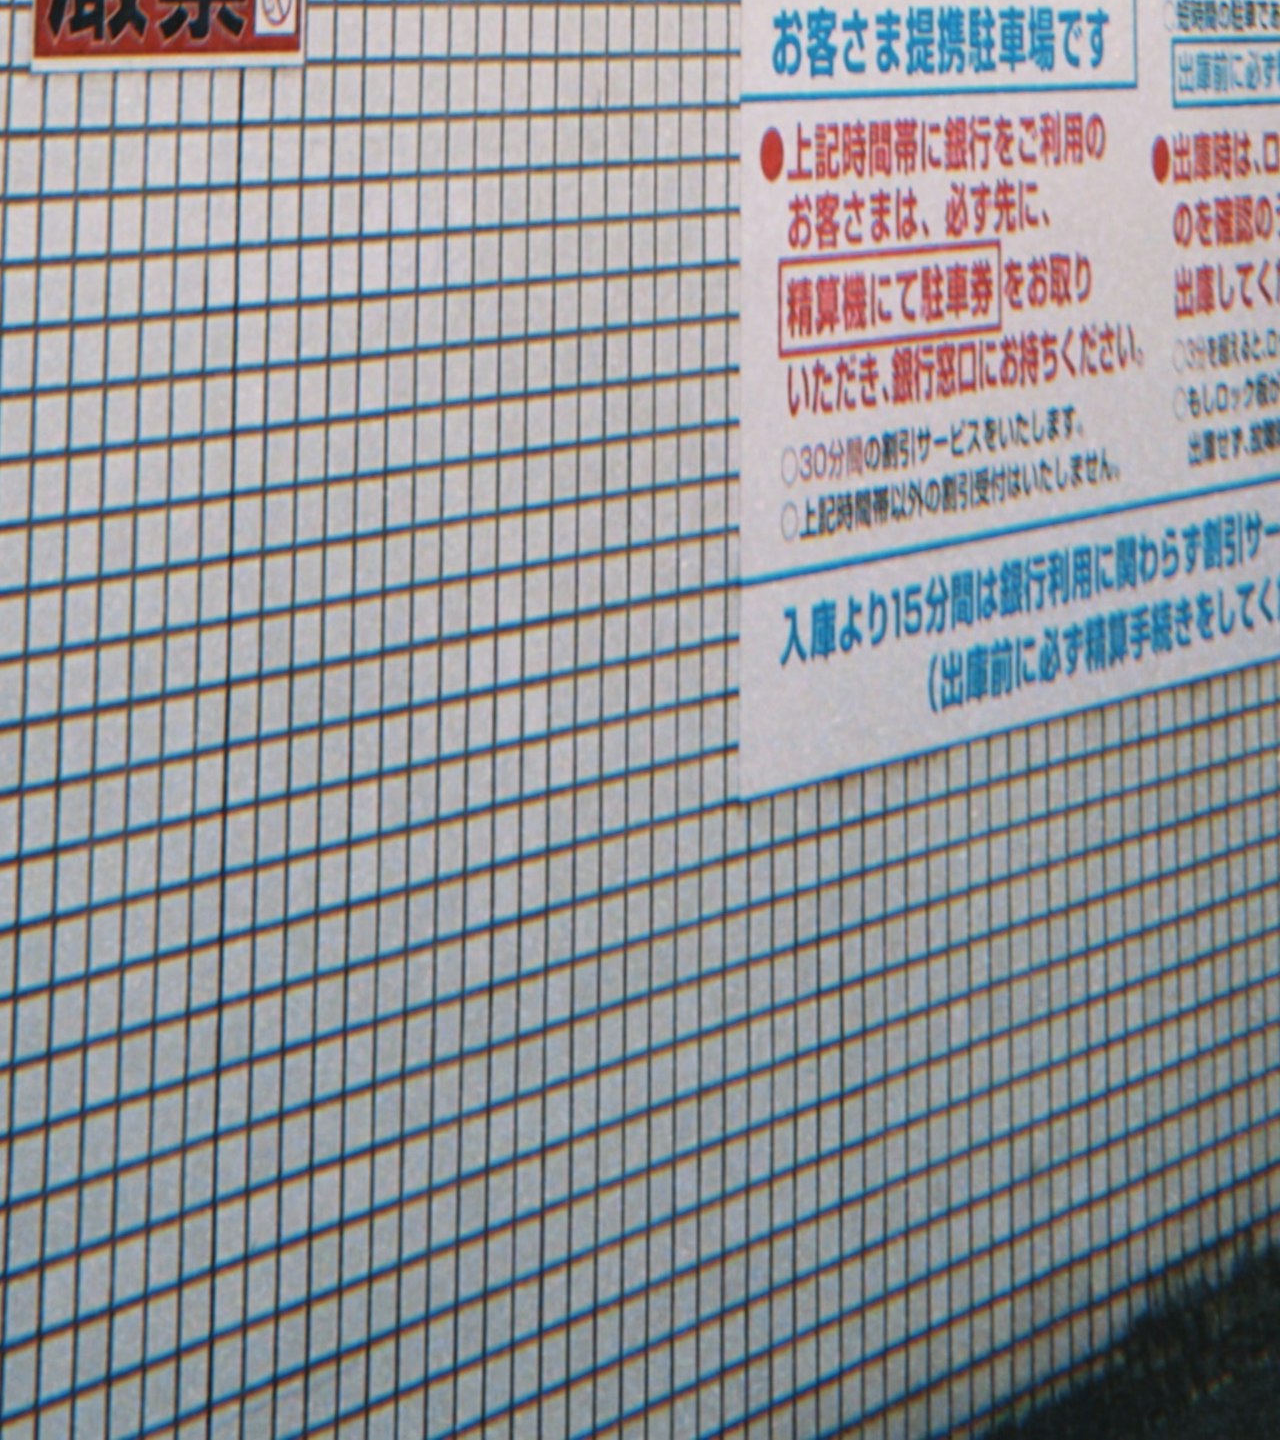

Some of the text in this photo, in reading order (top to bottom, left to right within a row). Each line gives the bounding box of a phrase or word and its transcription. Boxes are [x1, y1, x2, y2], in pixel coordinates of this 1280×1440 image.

[772, 6, 1110, 78] お客さま提携駐車場です
[786, 112, 1106, 180] 上記時間帯に銀行をご利用の
[787, 321, 1144, 417] いただき、銀行窓口にお持ちください。
